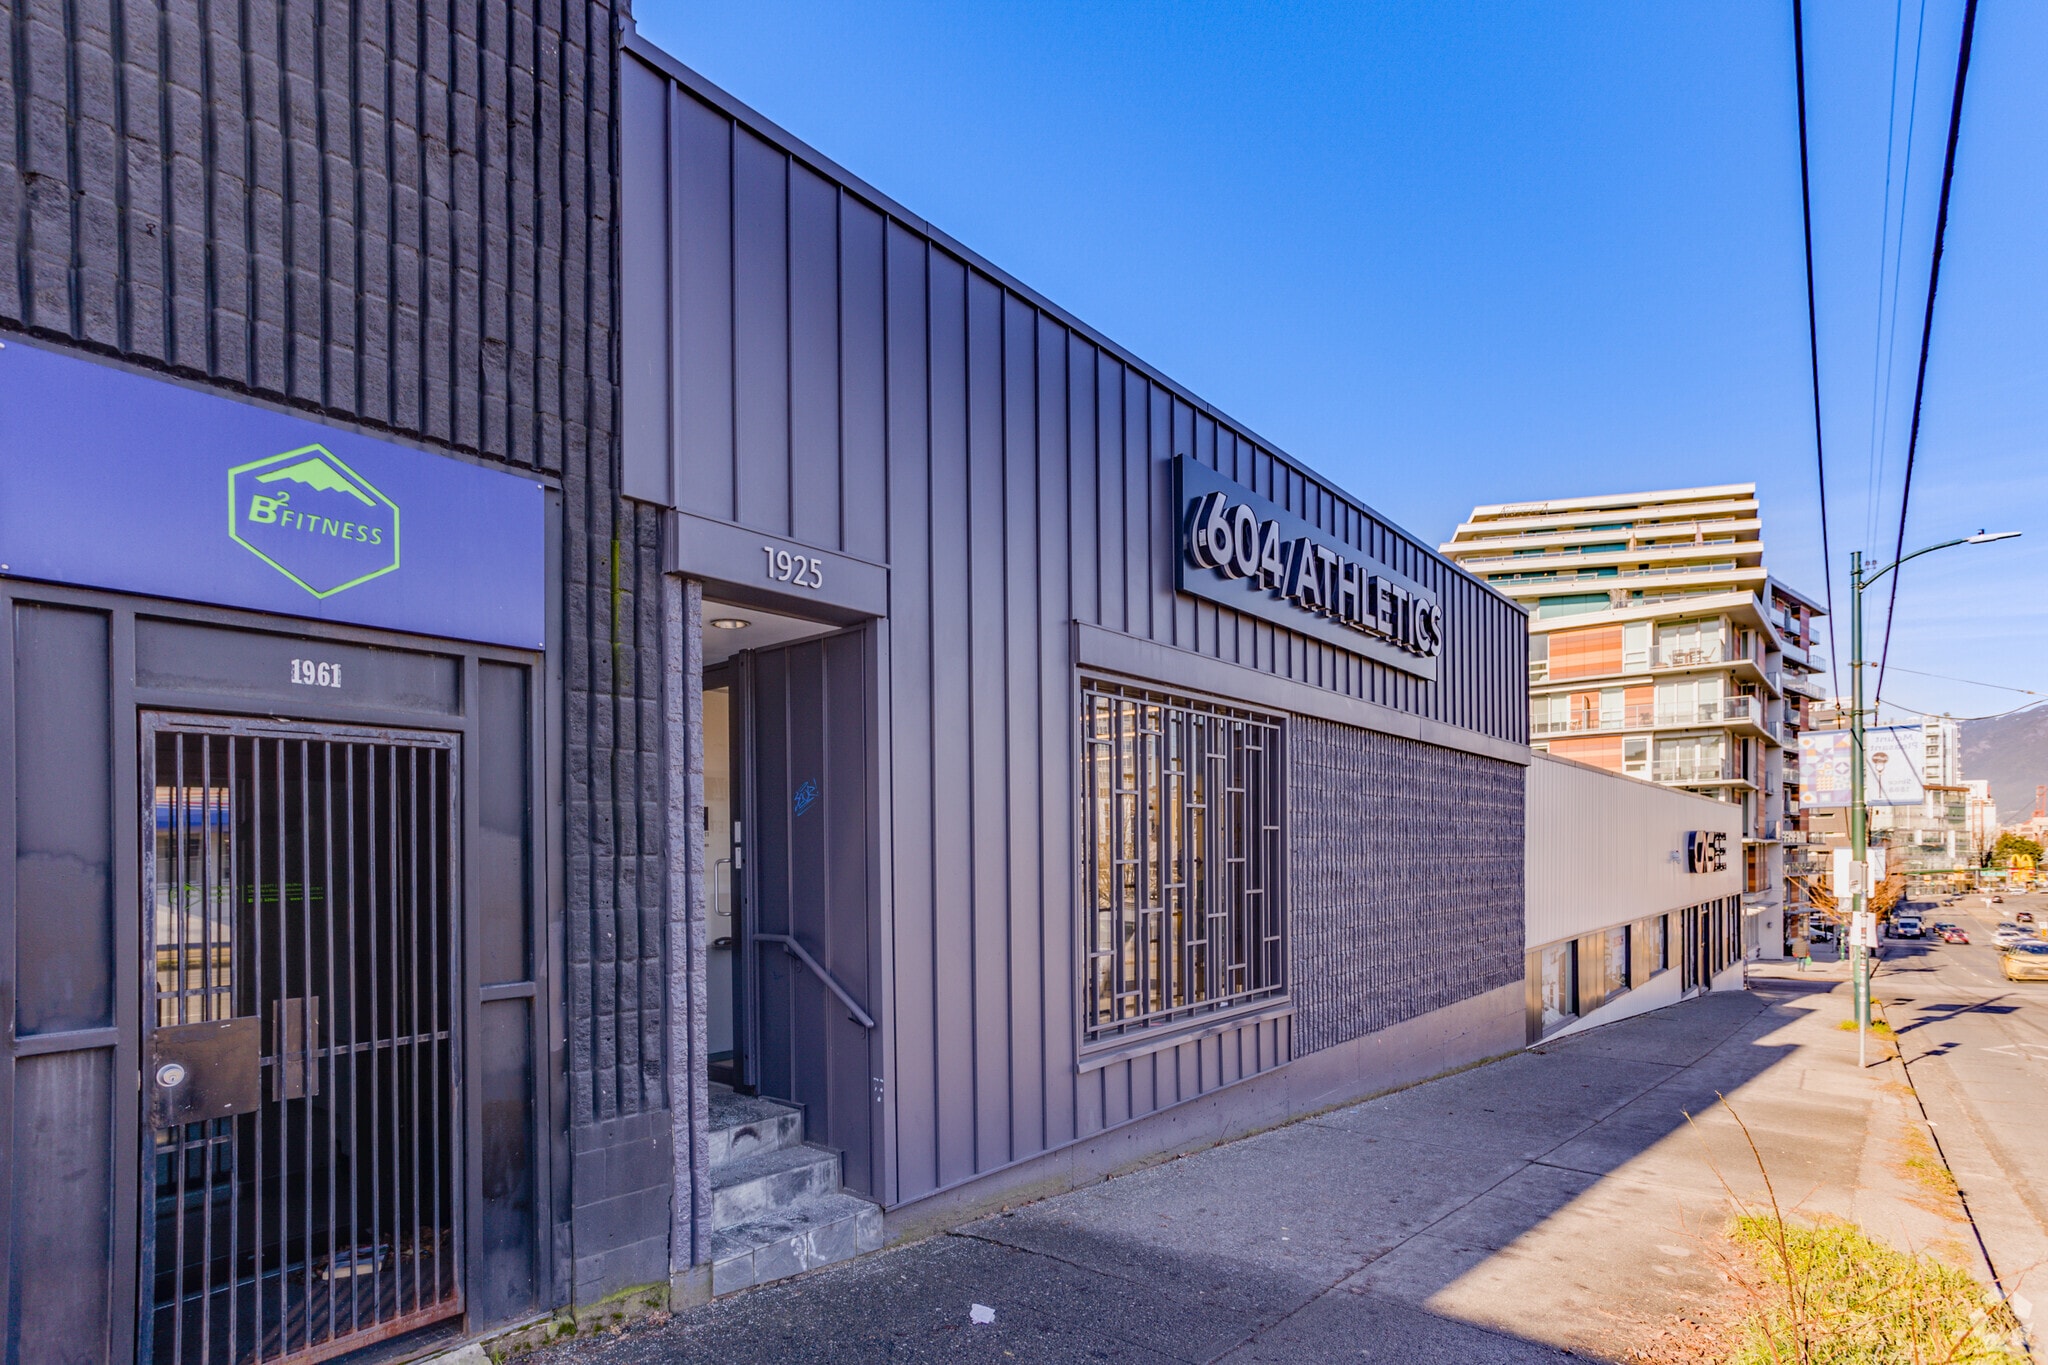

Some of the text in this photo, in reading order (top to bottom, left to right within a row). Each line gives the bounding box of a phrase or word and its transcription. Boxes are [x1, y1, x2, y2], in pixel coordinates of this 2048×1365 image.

[280, 510, 383, 545] FITNESS
[763, 546, 823, 589] 1925
[1191, 491, 1442, 657] 604 ATHLETICS
[291, 658, 342, 689] 1961
